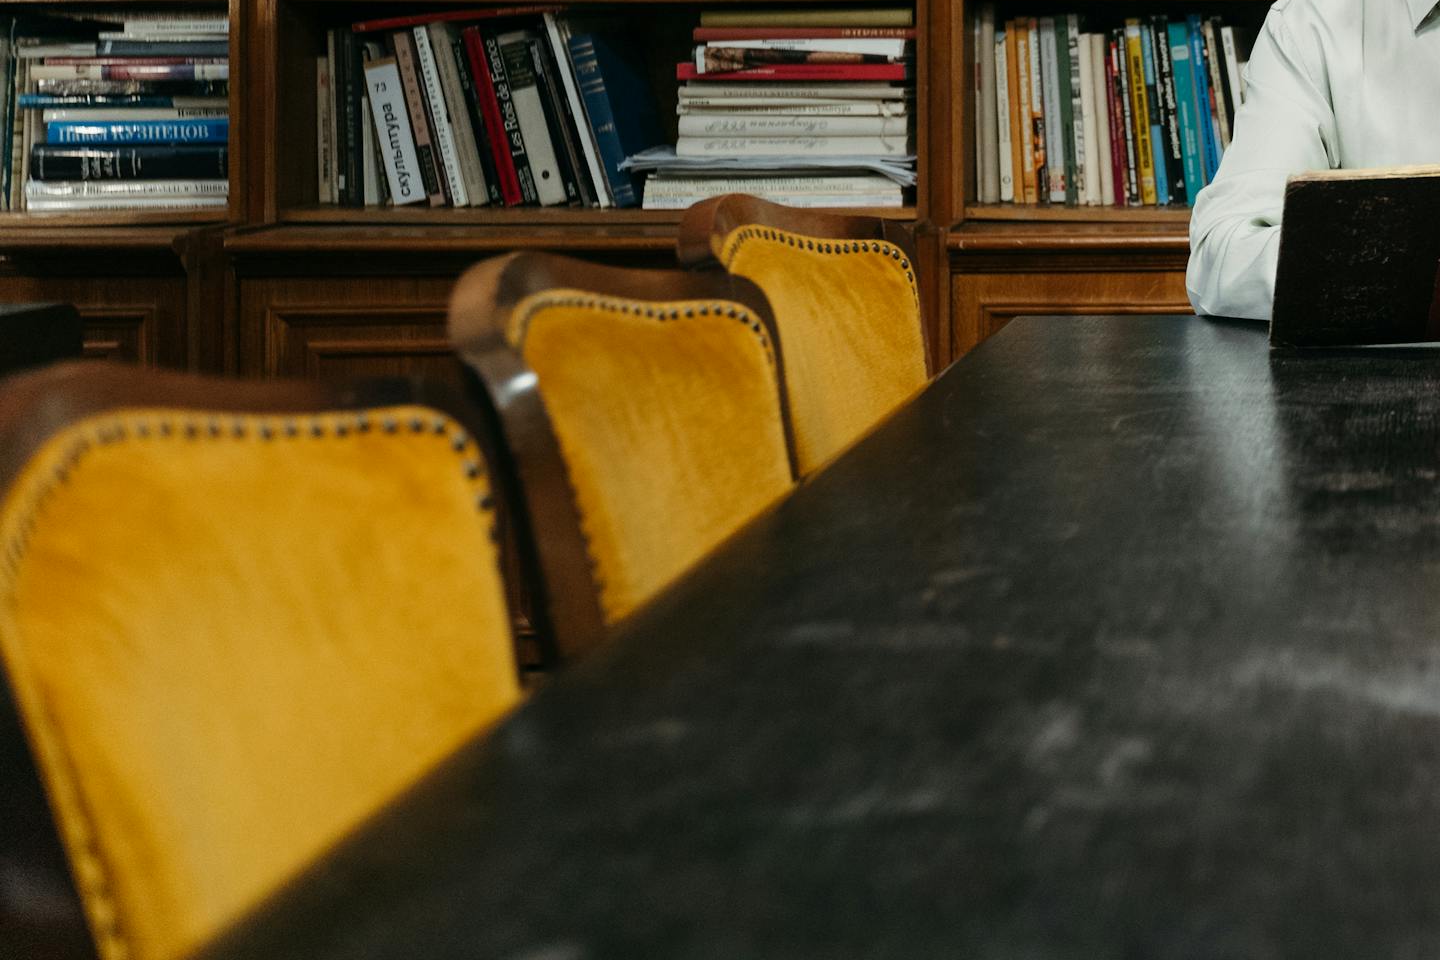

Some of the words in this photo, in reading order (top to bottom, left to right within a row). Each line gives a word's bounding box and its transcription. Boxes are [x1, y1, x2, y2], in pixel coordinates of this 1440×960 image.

[486, 39, 505, 81] France
[498, 83, 509, 100] de
[503, 102, 519, 130] Rois
[382, 101, 411, 197] скульптура
[512, 131, 525, 158] Les
